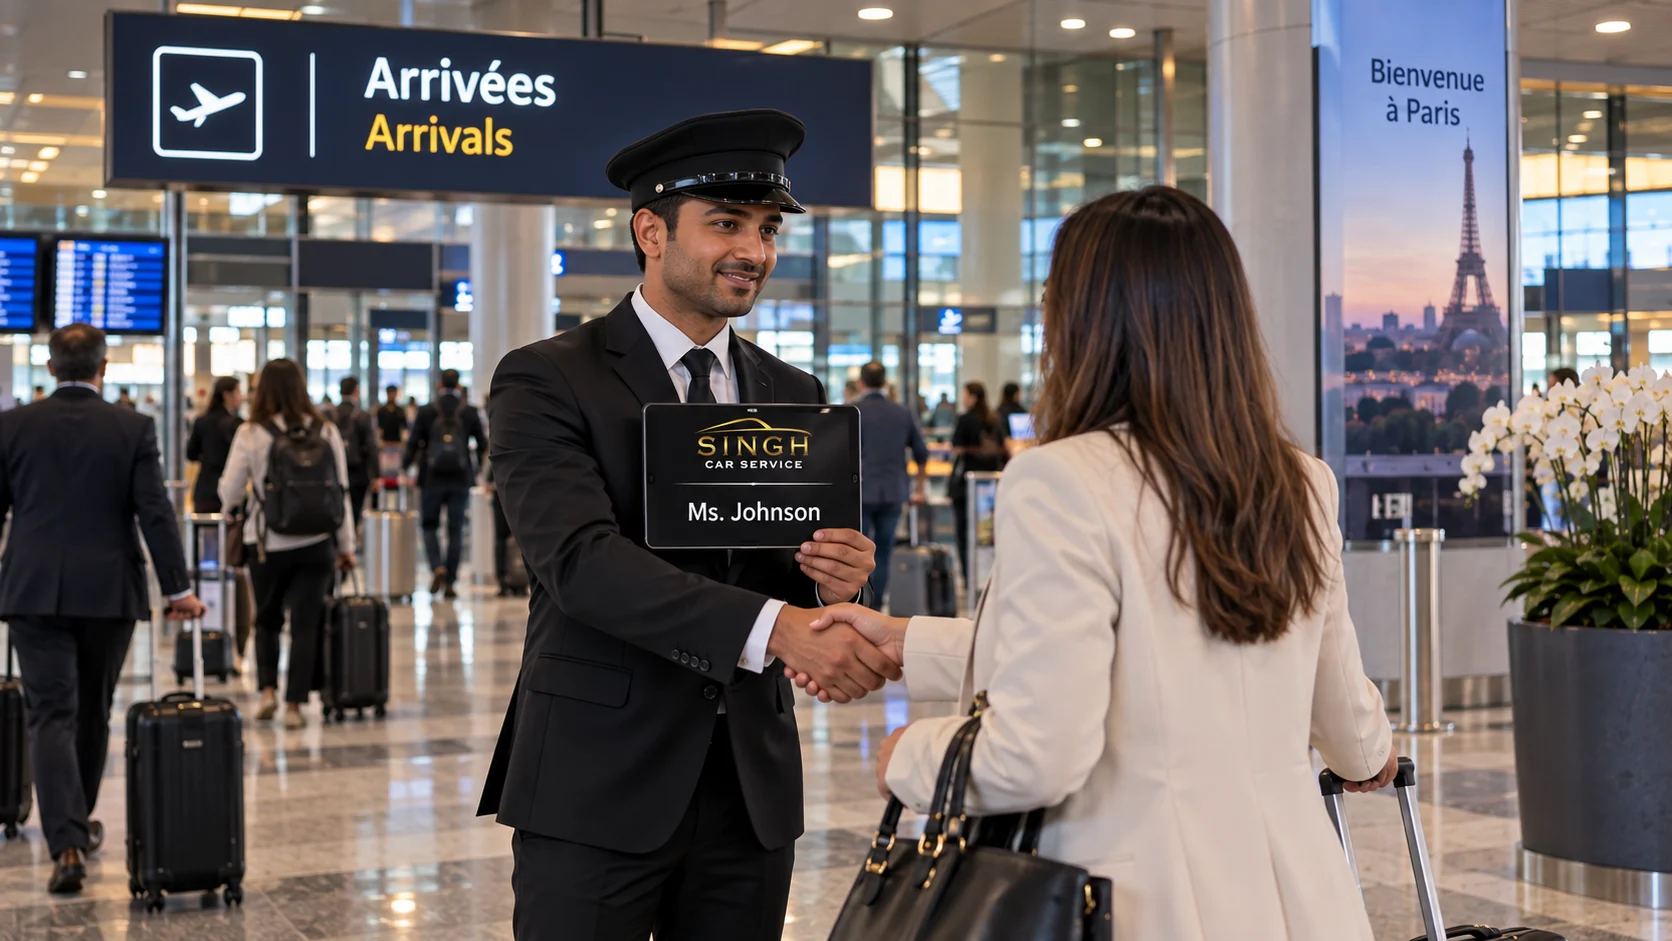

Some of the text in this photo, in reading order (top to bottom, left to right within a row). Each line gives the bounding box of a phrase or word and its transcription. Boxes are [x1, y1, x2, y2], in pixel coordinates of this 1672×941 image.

[364, 57, 557, 107] Arrivées
[1371, 58, 1485, 92] Bienvenue
[1387, 96, 1461, 126] à Paris
[365, 114, 514, 157] Arrivals
[697, 436, 809, 456] SINGH
[705, 460, 802, 469] CAR SERVICE
[688, 501, 821, 522] Ms. Johnson
